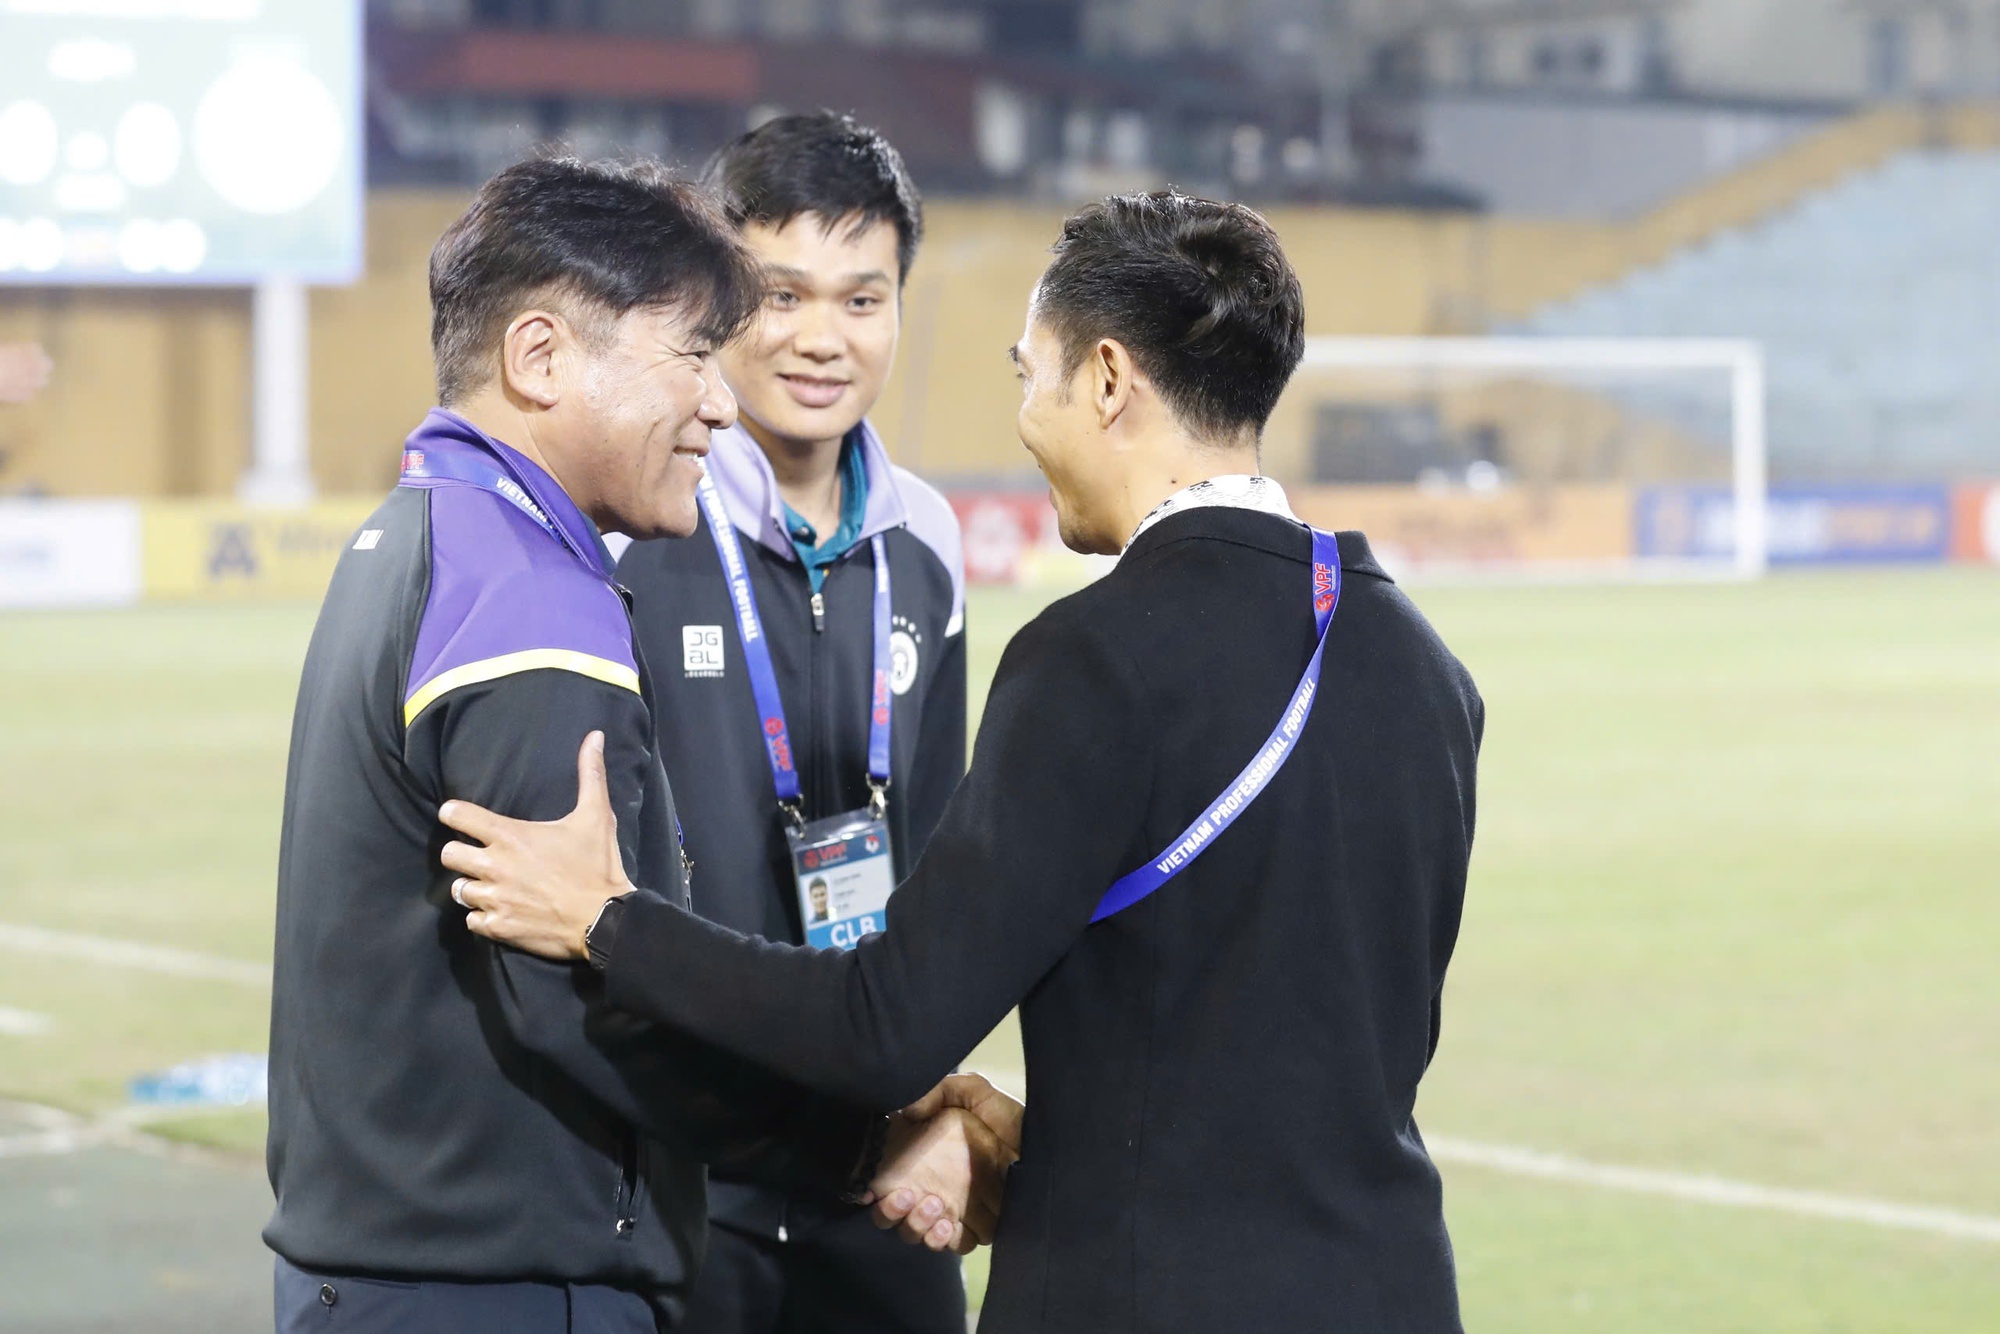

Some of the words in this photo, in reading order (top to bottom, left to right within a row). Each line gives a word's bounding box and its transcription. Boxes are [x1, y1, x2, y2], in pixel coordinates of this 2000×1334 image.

[496, 477, 548, 523] VIETNAM
[1314, 562, 1332, 595] VPF
[733, 578, 758, 643] FOOTBALL
[1156, 821, 1215, 875] VIETNAM
[1210, 736, 1289, 826] PROFESSIONAL
[1282, 677, 1316, 739] FOOTBALL
[830, 916, 878, 948] CLB
